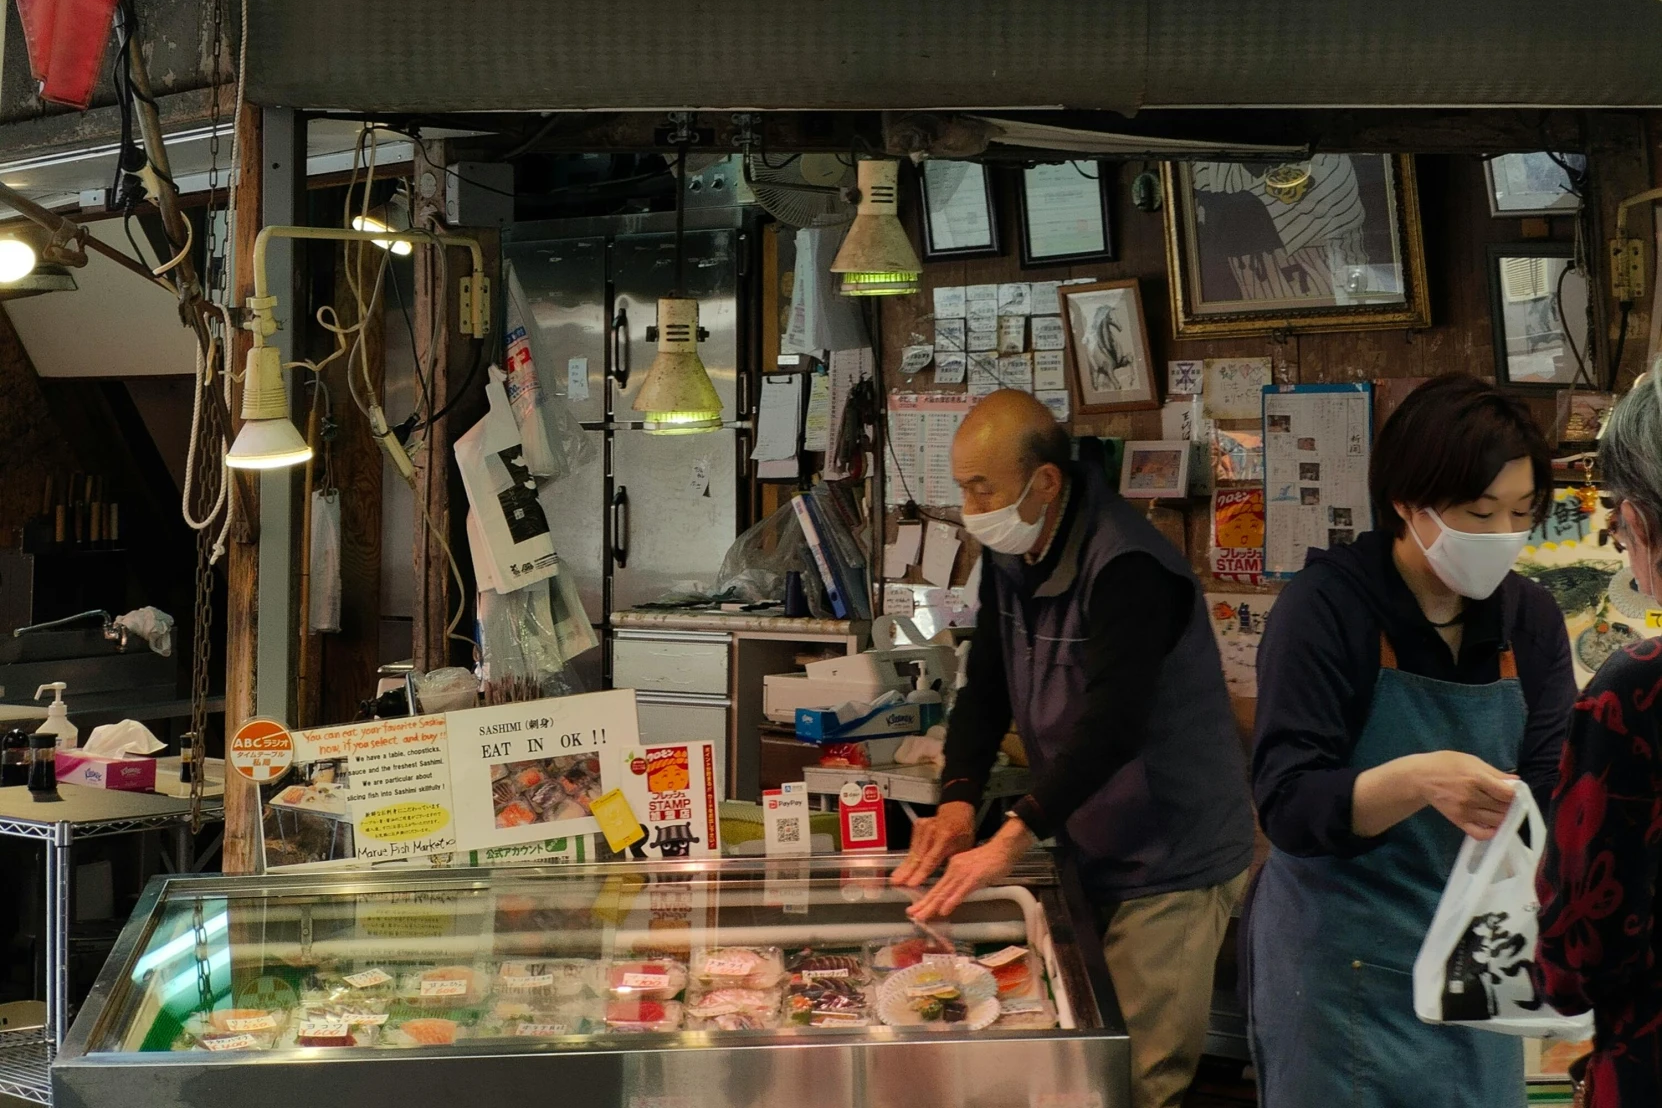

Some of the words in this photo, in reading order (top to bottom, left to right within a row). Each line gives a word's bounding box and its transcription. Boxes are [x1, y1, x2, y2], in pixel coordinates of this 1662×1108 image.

[1216, 559, 1262, 572] STAM
[303, 731, 321, 743] You
[323, 731, 340, 740] can
[342, 729, 358, 738] eat
[382, 721, 417, 734] favorite
[479, 721, 522, 736] SASHIMI
[371, 735, 398, 749] select
[402, 732, 419, 743] and
[421, 732, 438, 744] buy
[482, 742, 511, 758] EAT
[527, 737, 544, 752] IN
[560, 732, 582, 748] OK
[592, 728, 606, 745] !!
[646, 749, 675, 762] クロモン
[393, 761, 418, 771] freshest
[385, 774, 414, 785] particular
[415, 772, 433, 781] about
[347, 794, 366, 802] slicing
[367, 792, 379, 800] fish
[381, 789, 392, 797] into
[394, 787, 417, 796] Sashimi
[652, 791, 686, 800] フレッシュ
[649, 798, 691, 811] STAMP
[778, 800, 803, 808] PayPay
[390, 842, 410, 857] Fish
[412, 837, 445, 853] Market
[486, 844, 543, 860] 公式アカウント
